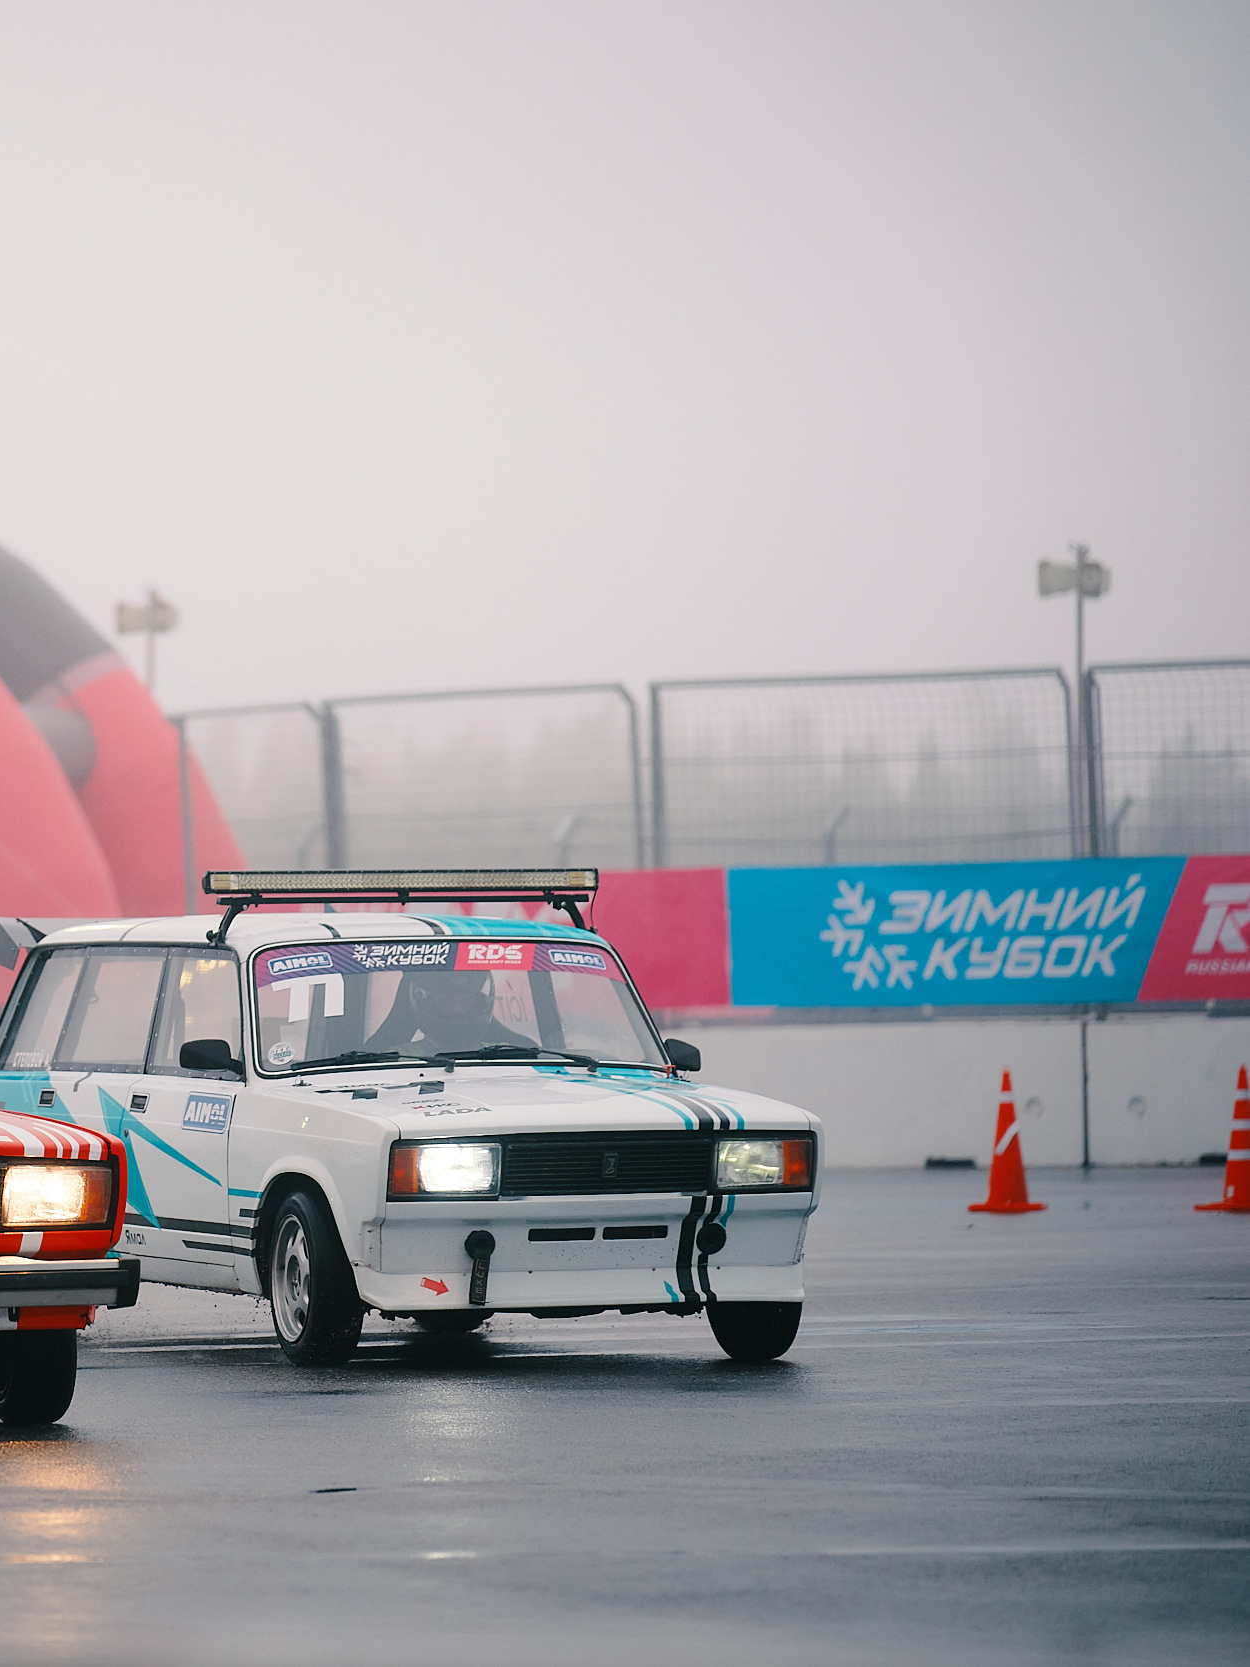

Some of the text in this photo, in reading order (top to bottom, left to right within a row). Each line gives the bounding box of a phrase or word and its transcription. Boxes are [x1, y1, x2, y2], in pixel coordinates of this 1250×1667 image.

[878, 872, 1146, 935] ЗИМНИЙ
[370, 942, 450, 955] ЗИМНИЙ
[468, 944, 523, 960] RDS
[922, 933, 1128, 980] КУБОК
[272, 955, 330, 972] AIMOL
[386, 953, 448, 966] КУБОК
[553, 953, 605, 967] AIMOL
[184, 1101, 226, 1123] AIMOL
[423, 1107, 493, 1117] LADA
